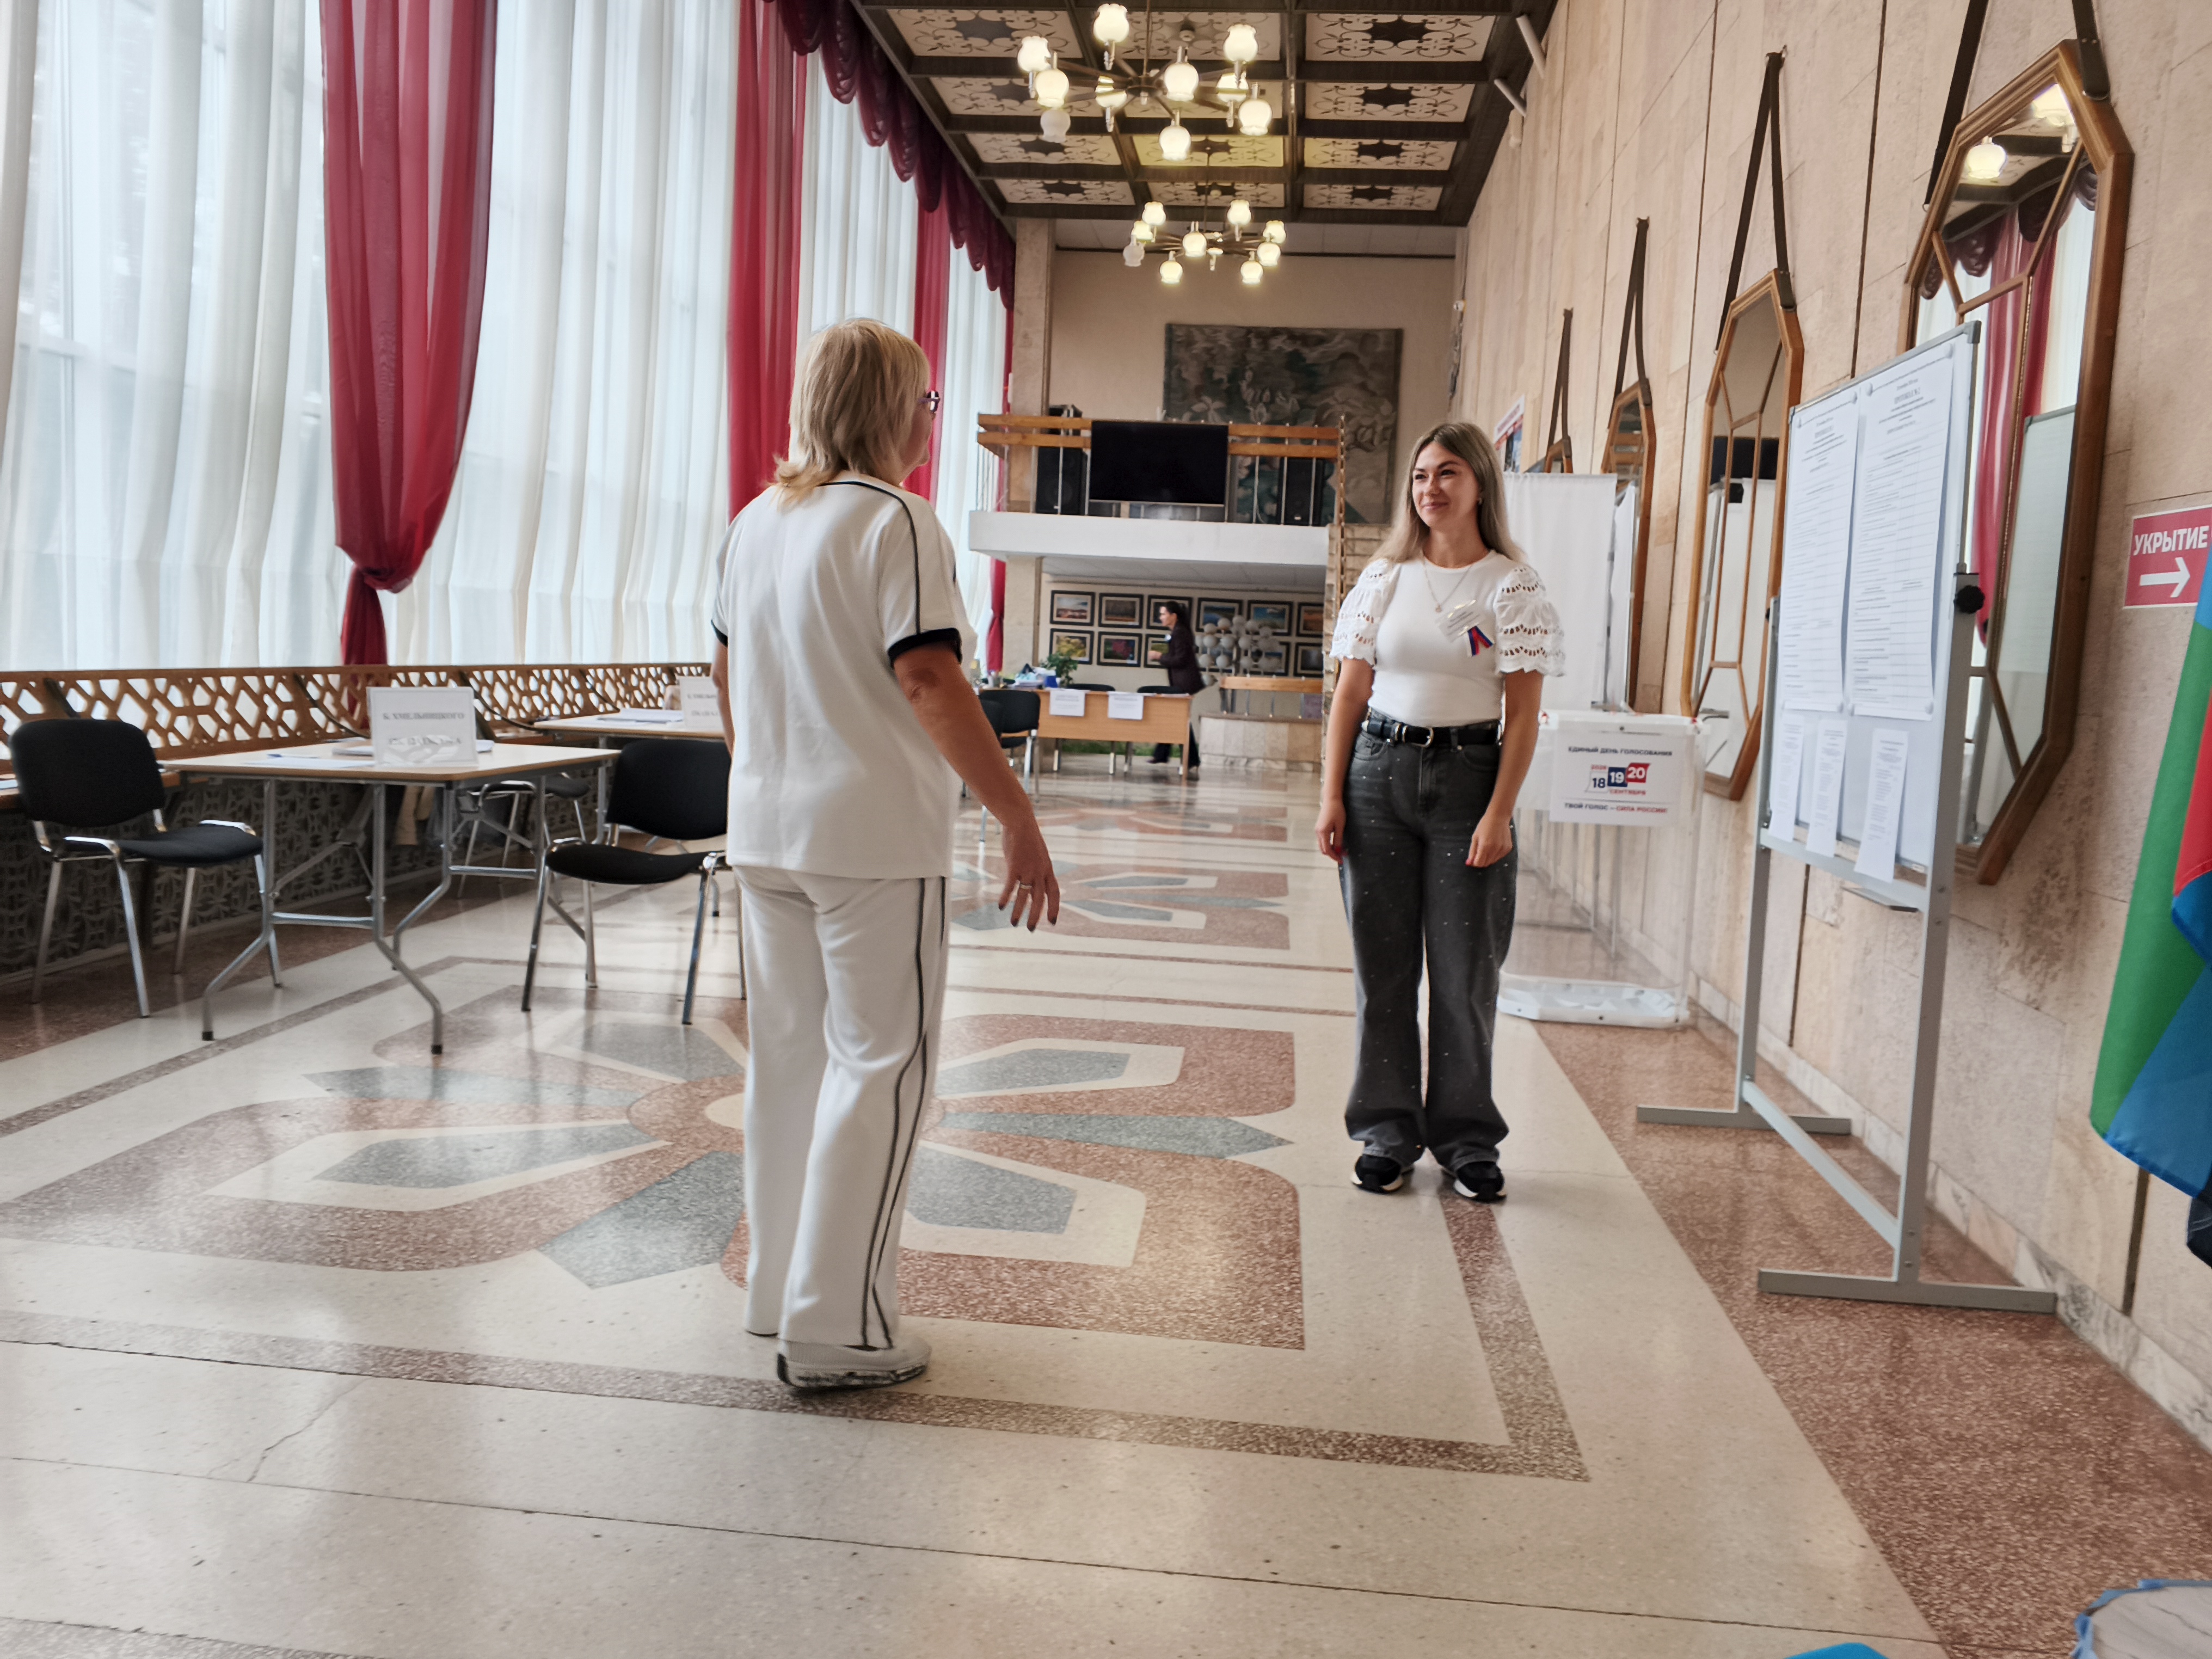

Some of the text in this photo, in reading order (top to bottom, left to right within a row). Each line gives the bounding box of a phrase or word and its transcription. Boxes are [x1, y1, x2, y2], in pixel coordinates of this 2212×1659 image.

[2133, 525, 2210, 556] УКРЫТИЕ
[1592, 766, 1645, 788] 18 19 20
